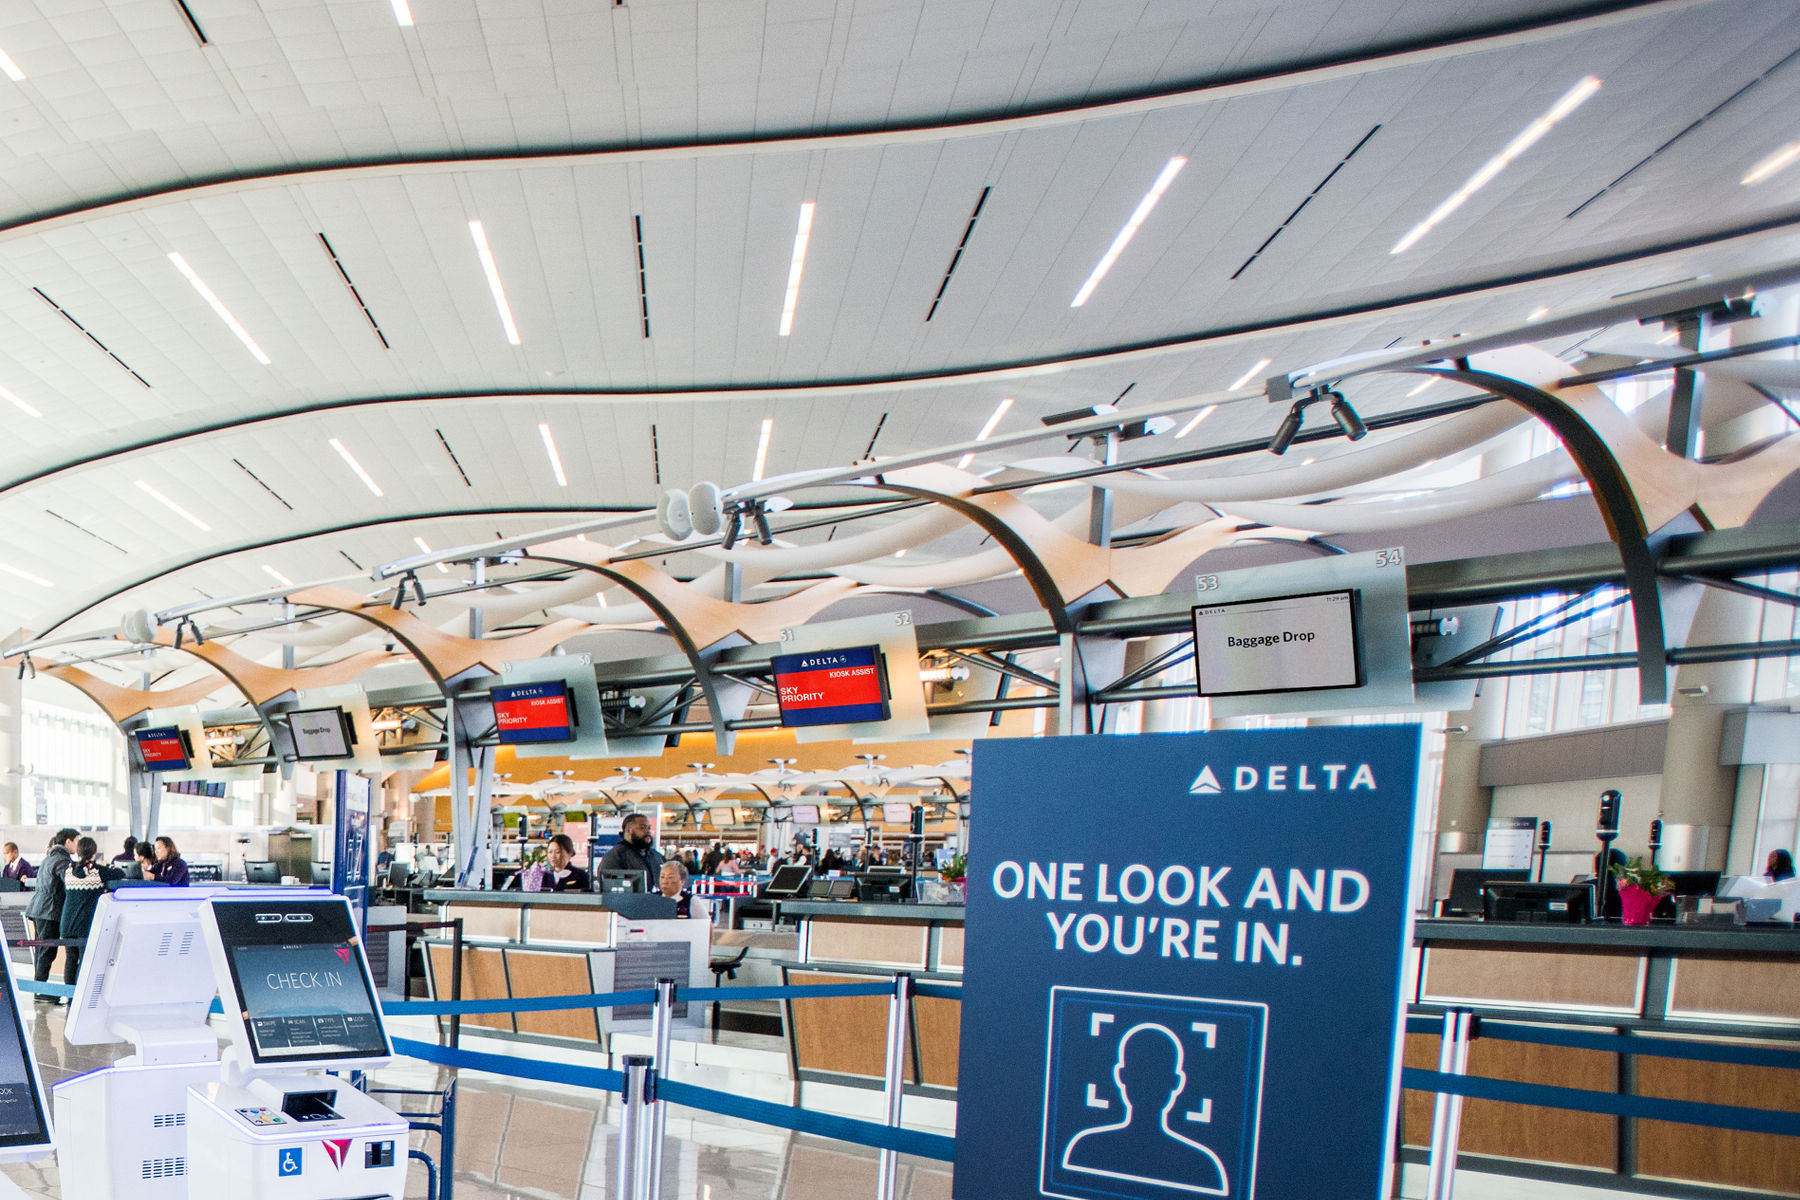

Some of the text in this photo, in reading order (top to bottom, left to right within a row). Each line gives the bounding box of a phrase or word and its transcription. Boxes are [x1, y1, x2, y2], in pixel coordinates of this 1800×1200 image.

[1375, 550, 1402, 568] 54
[1198, 575, 1219, 592] 53
[1205, 608, 1226, 616] DELTA
[895, 612, 911, 626] 52
[780, 629, 794, 642] 51
[1228, 631, 1316, 649] Baggage Drop
[580, 655, 591, 665] 50
[810, 656, 839, 666] DELTA
[829, 668, 875, 678] KIOSK ASSIST
[517, 689, 537, 697] DELTA
[780, 687, 798, 695] SKY
[781, 692, 824, 703] PRIORITY
[498, 717, 528, 725] PRIORITY
[1234, 763, 1377, 791] DELTA
[991, 860, 1371, 913] ONE LOOK AND
[1045, 911, 1303, 966] YOU'RE IN.
[266, 971, 343, 990] CHECK IN
